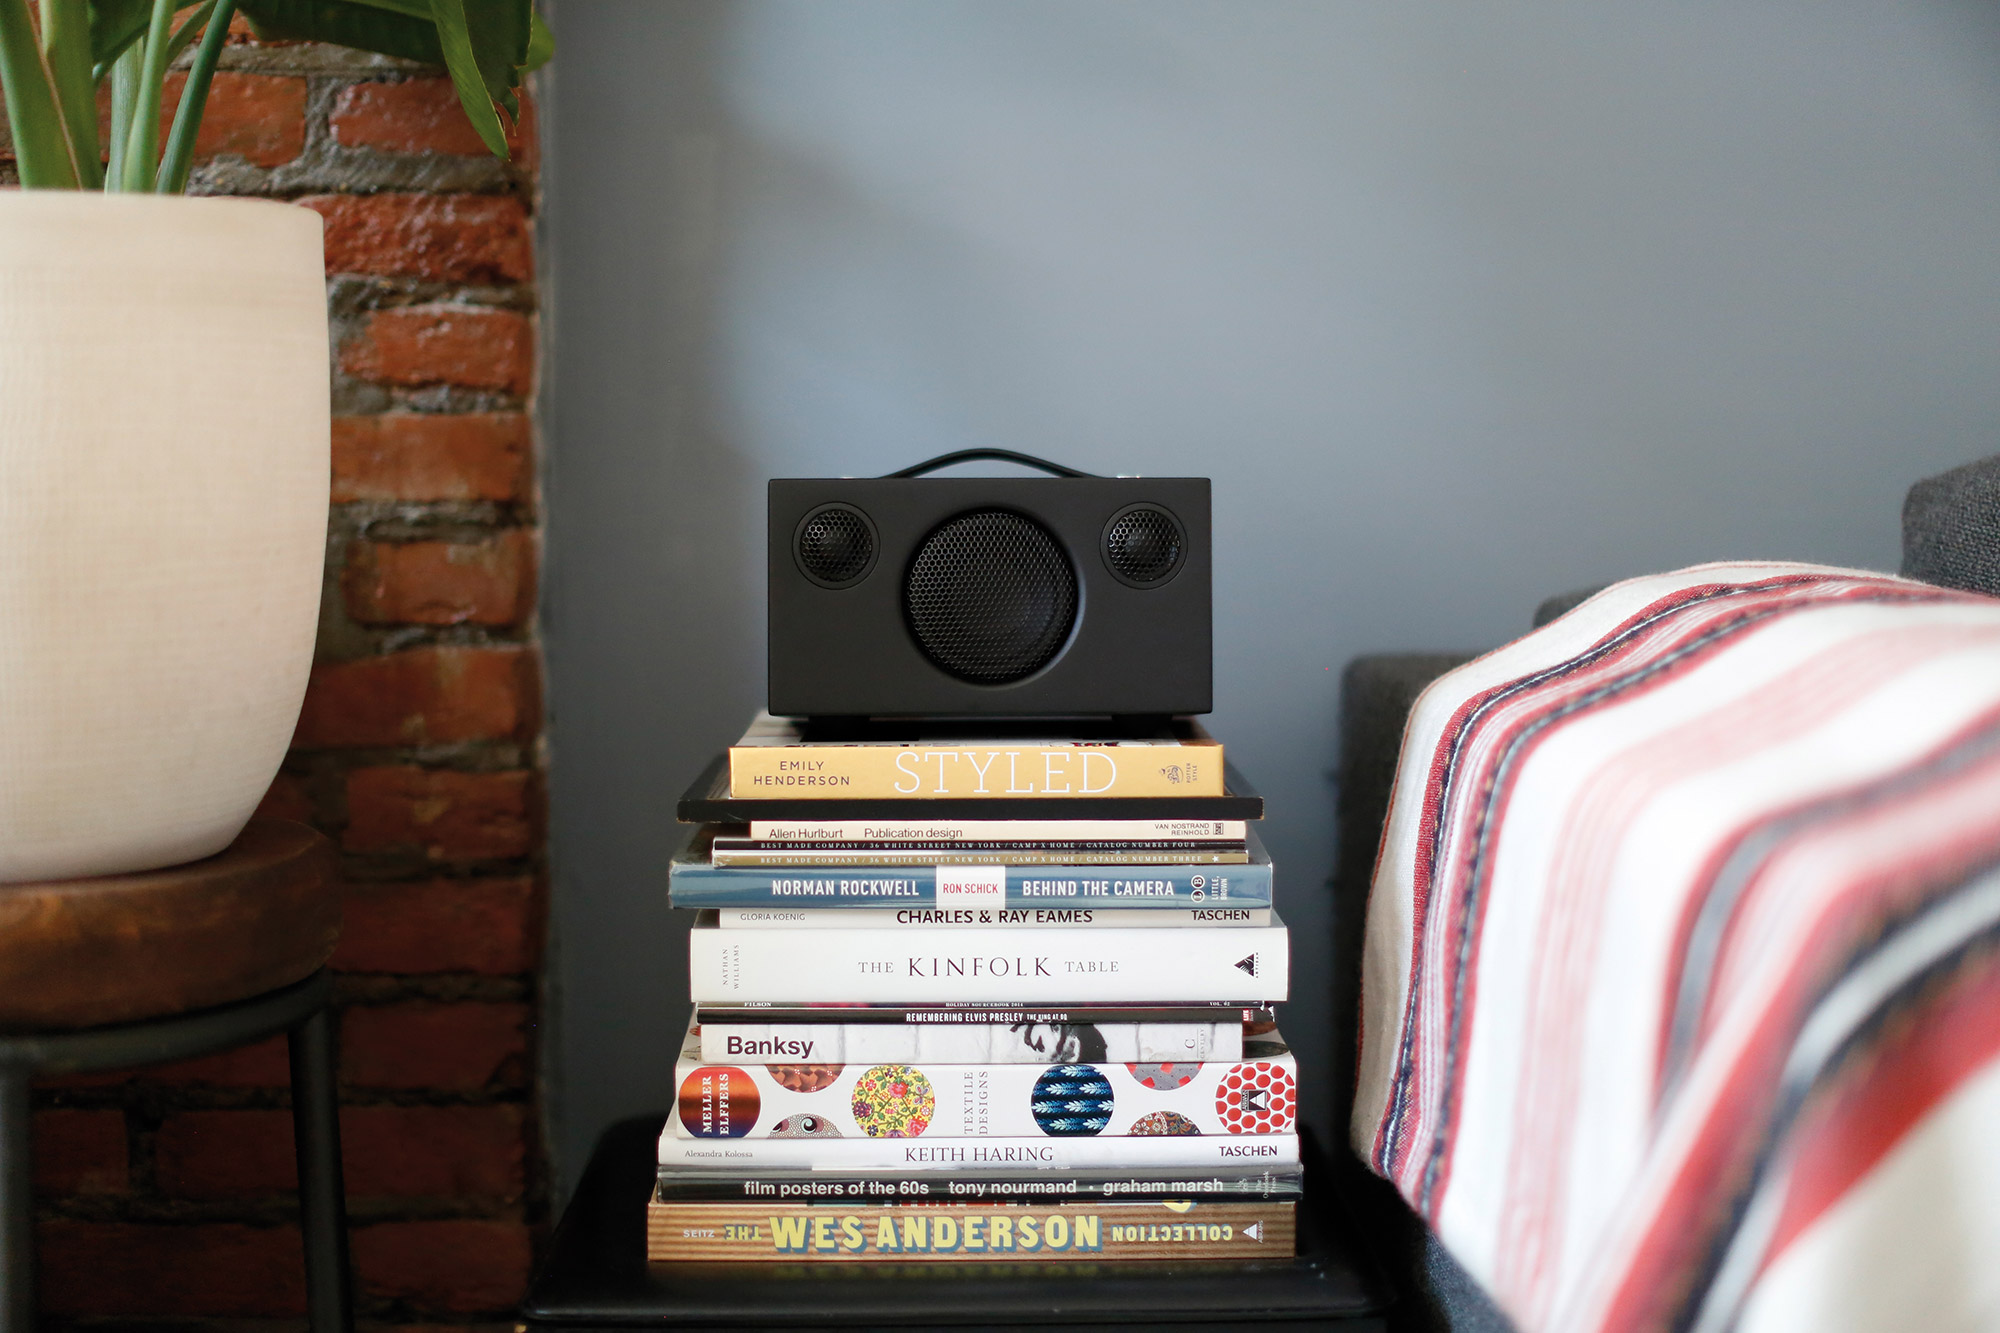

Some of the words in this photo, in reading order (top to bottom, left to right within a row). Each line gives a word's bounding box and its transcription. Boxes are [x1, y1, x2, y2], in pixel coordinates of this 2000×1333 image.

[780, 760, 824, 771] EMILY
[894, 751, 1117, 794] STYLED
[754, 776, 850, 785] HENDERSON
[769, 828, 796, 838] Allen
[798, 828, 843, 838] Hurlburt
[864, 827, 924, 838] Publication
[926, 828, 963, 840] design
[772, 879, 835, 896] NORMAN
[840, 879, 919, 896] ROCKWELL
[943, 883, 962, 894] RON
[964, 883, 999, 894] SCHICK
[1022, 880, 1077, 896] BEHIND
[1082, 880, 1109, 896] THE
[1114, 880, 1174, 896] CAMERA
[1211, 875, 1220, 900] LITTLE,
[1220, 878, 1228, 900] BROWN
[740, 913, 771, 921] GLORIA
[773, 913, 806, 921] KOENIG
[896, 910, 973, 924] CHARLES
[978, 910, 992, 924] &
[999, 910, 1030, 923] RAY
[1036, 910, 1093, 923] EAMES
[1191, 910, 1250, 920] TASCHEN
[858, 961, 894, 973] THE
[908, 957, 1052, 977] KINFOLK
[1064, 961, 1119, 973] TABLE
[905, 1012, 963, 1022] REMEMBERING
[965, 1012, 987, 1022] ELVIS
[989, 1012, 1024, 1022] PRESLEY
[1026, 1013, 1037, 1021] THE
[727, 1035, 814, 1059] Banksy
[1184, 1039, 1195, 1049] C
[702, 1075, 712, 1133] MELLER
[719, 1073, 729, 1135] ELFFERS
[964, 1071, 973, 1134] TEXTILE
[978, 1070, 988, 1135] DESIGNS
[685, 1150, 722, 1158] Alexandra
[724, 1150, 753, 1158] Kolossa
[905, 1147, 964, 1162] KEITH
[974, 1147, 1053, 1161] HARING
[1219, 1145, 1278, 1157] TASCHEN
[744, 1180, 775, 1195] film
[780, 1181, 844, 1200] posters
[848, 1180, 865, 1195] of
[868, 1180, 896, 1195] the
[899, 1180, 929, 1195] 60s
[949, 1181, 986, 1198] tony
[991, 1179, 1077, 1194] nourmand
[1103, 1178, 1167, 1196] graham
[1171, 1178, 1224, 1193] marsh
[683, 1229, 715, 1238] SEITZ
[724, 1224, 762, 1241] THE
[769, 1215, 868, 1253] WES
[876, 1215, 1103, 1253] ANDERSON
[1112, 1224, 1234, 1242] COLLECTION
